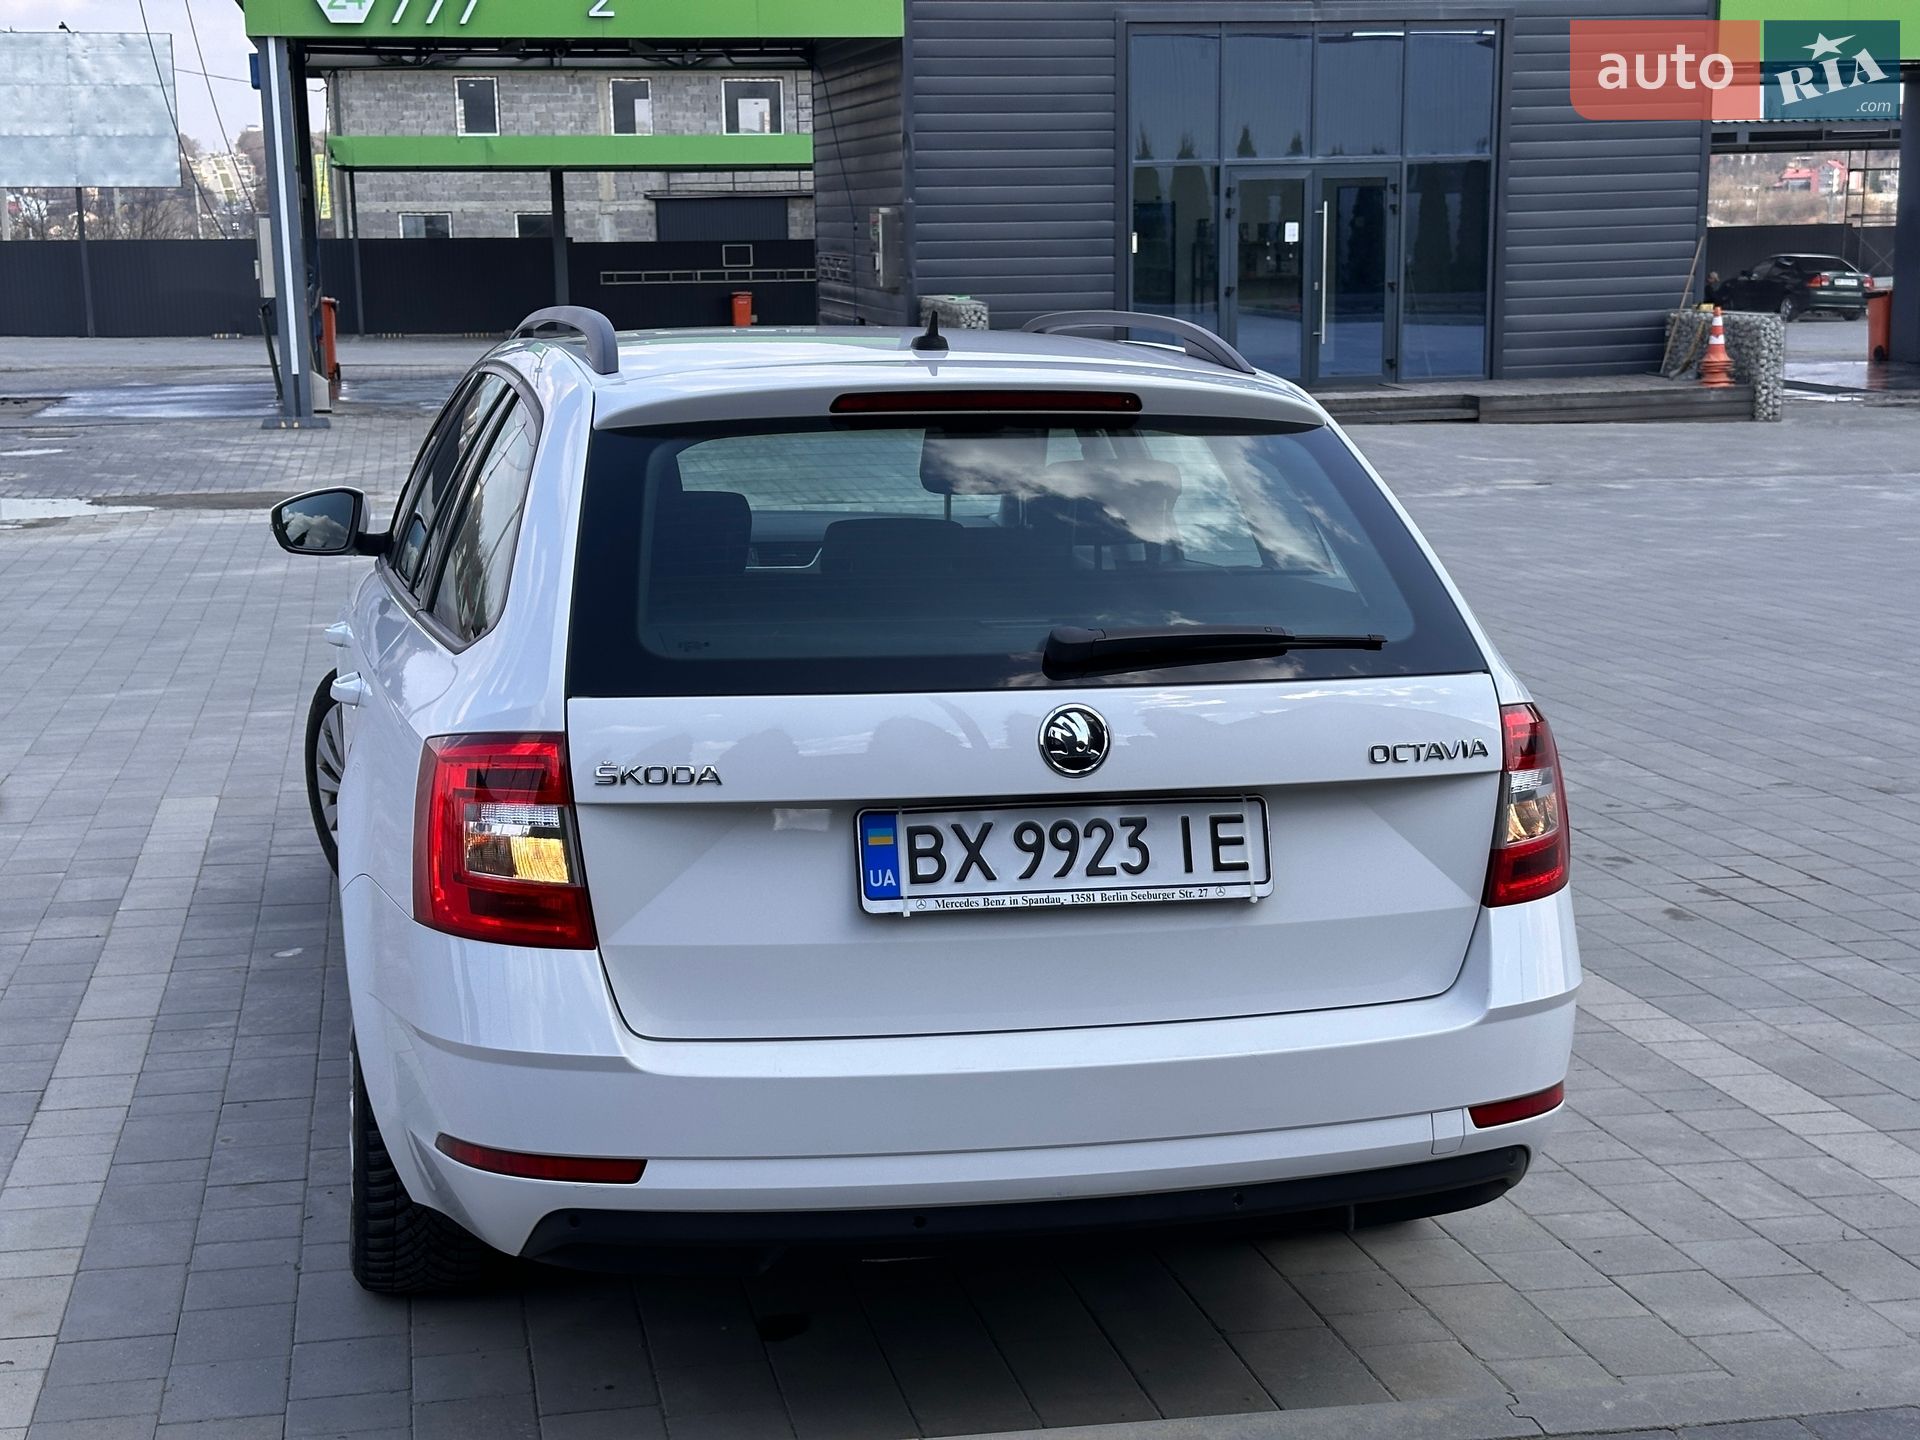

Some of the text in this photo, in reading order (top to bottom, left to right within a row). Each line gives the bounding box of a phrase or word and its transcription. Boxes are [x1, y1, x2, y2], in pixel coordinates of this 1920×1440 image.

[1368, 738, 1489, 764] OCTAVIA
[594, 760, 723, 786] ŠKODA
[906, 813, 1250, 885] BX 9923 IE
[869, 868, 896, 888] UA
[935, 898, 980, 910] Mercedes
[983, 897, 1006, 908] Benz
[1009, 896, 1019, 906] in
[1070, 892, 1096, 904] 13581
[1100, 892, 1128, 903] Berlin
[1130, 890, 1176, 901] Seeburger
[1178, 888, 1195, 899] Str.
[1198, 888, 1208, 898] 27
